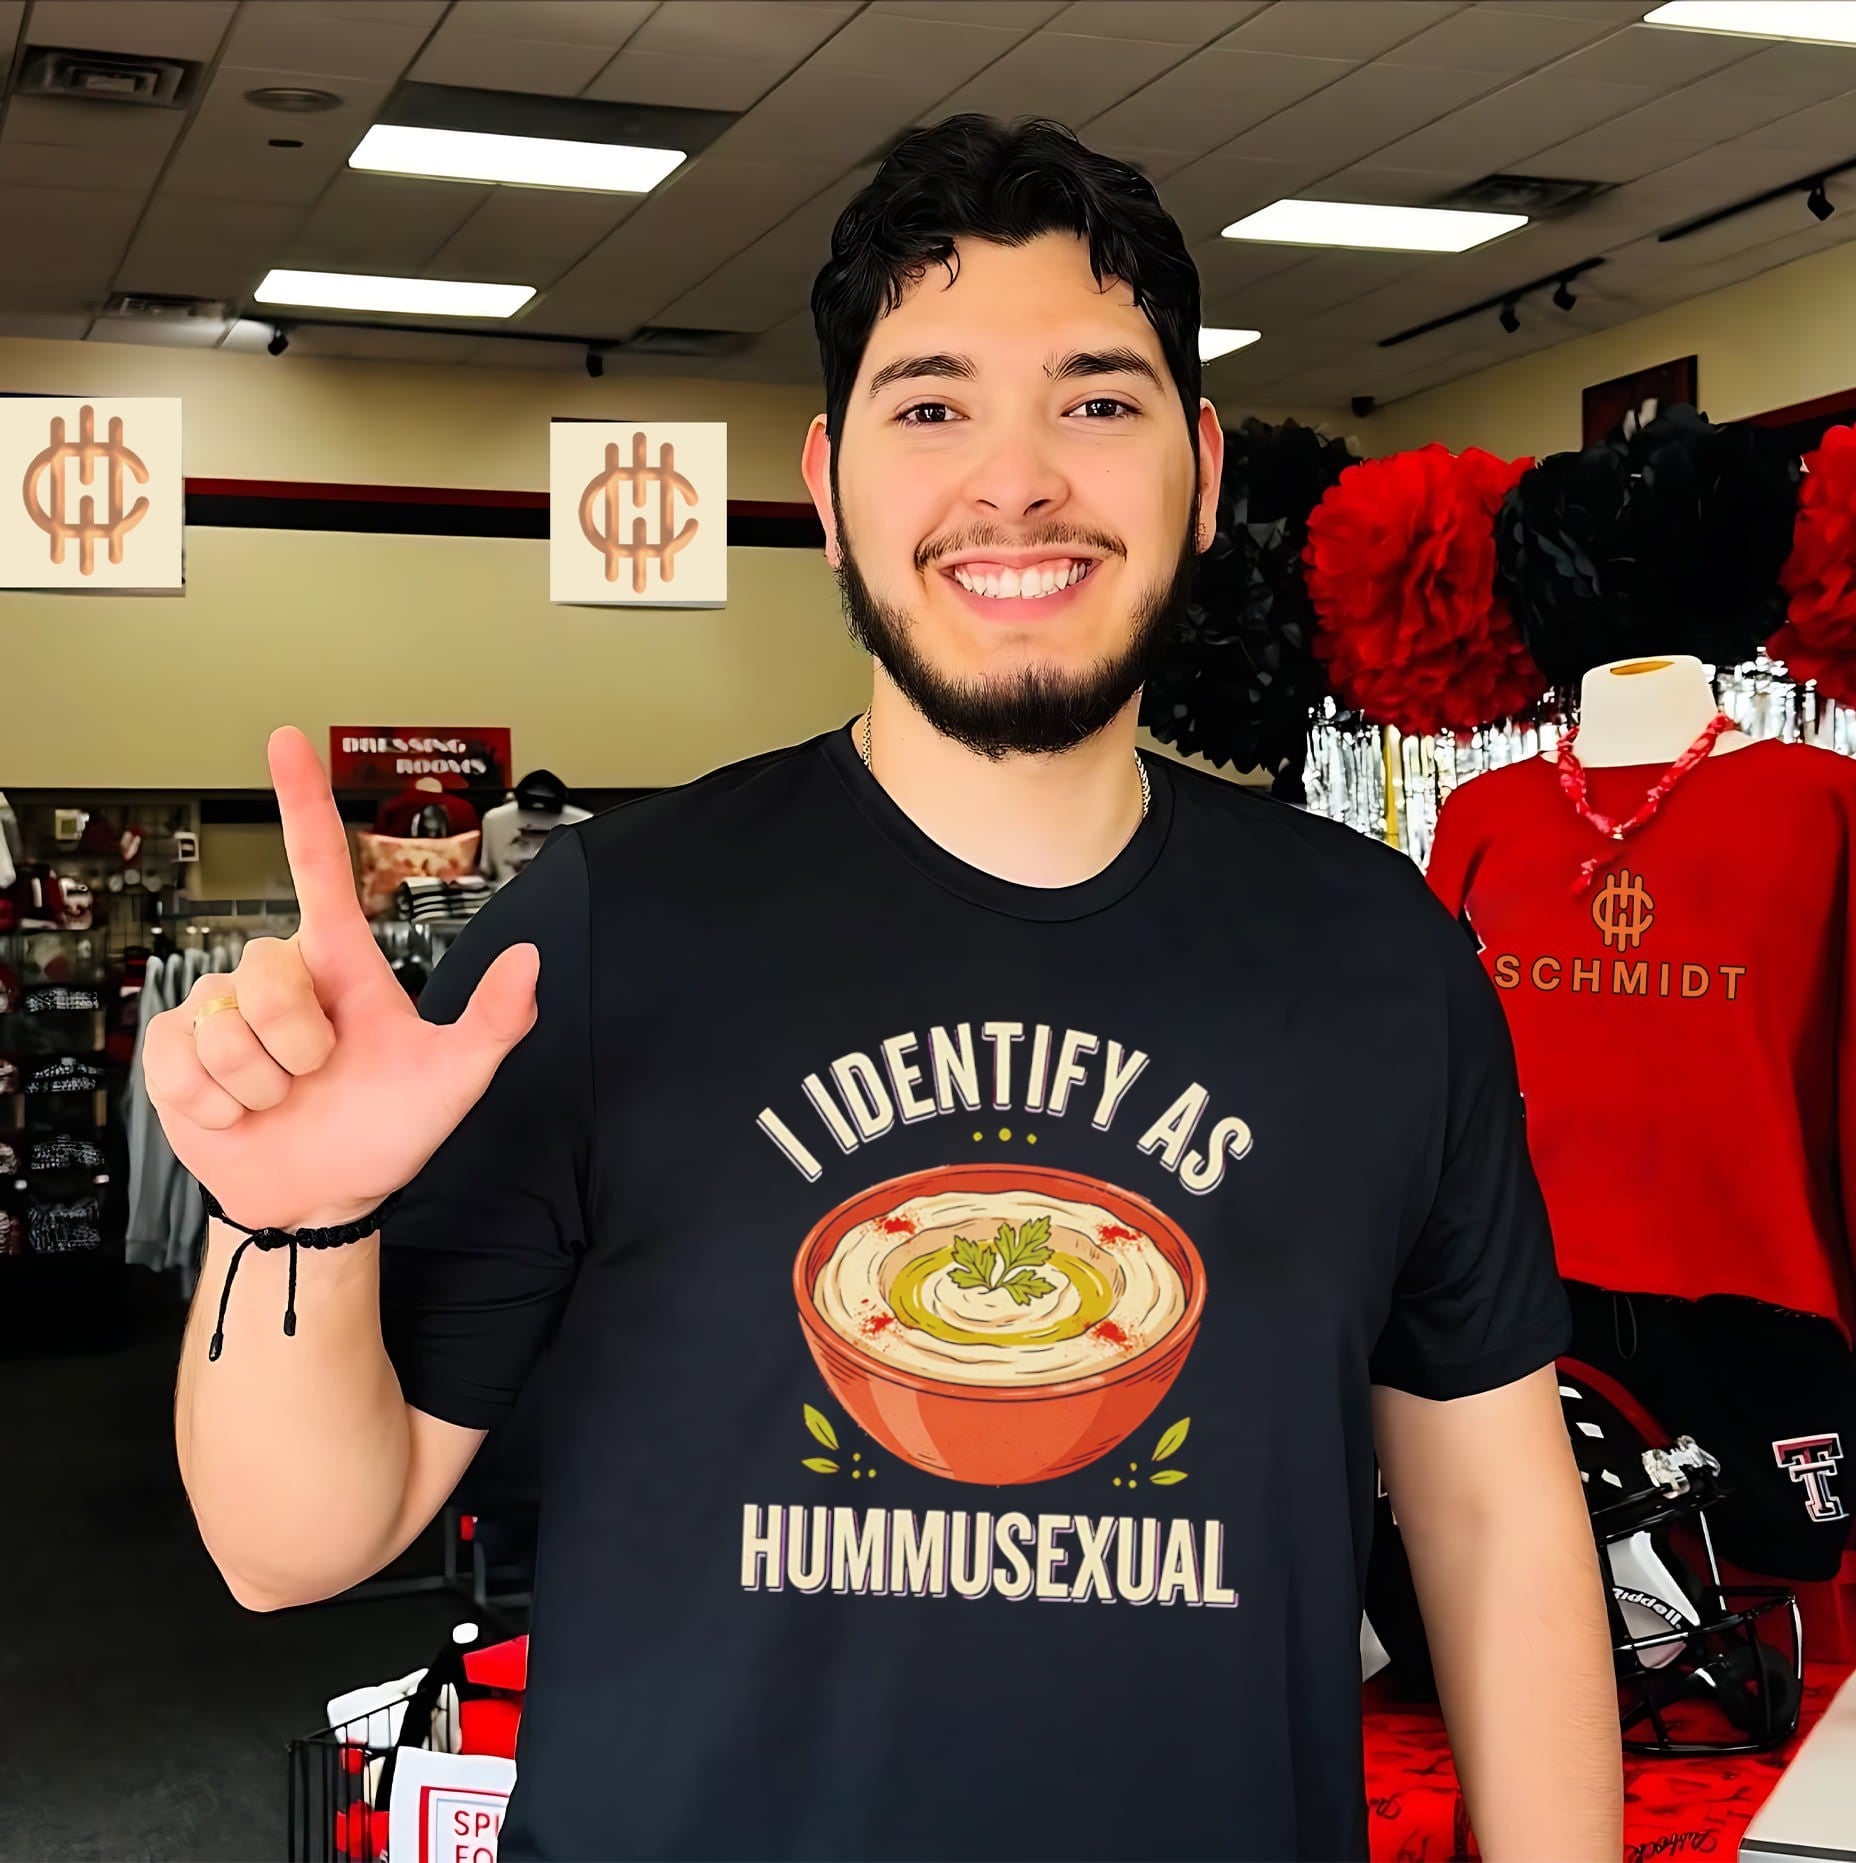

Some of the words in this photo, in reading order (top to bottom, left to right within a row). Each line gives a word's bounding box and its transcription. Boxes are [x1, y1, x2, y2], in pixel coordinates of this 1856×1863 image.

[342, 737, 466, 754] DRESSING
[396, 758, 487, 775] ROOMS
[1494, 954, 1746, 1000] SCHMIDT
[757, 1107, 823, 1183] I
[801, 1022, 1150, 1154] IDENTIFY
[1137, 1082, 1254, 1194] AS
[741, 1504, 1239, 1608] HUMMUSEXUAL
